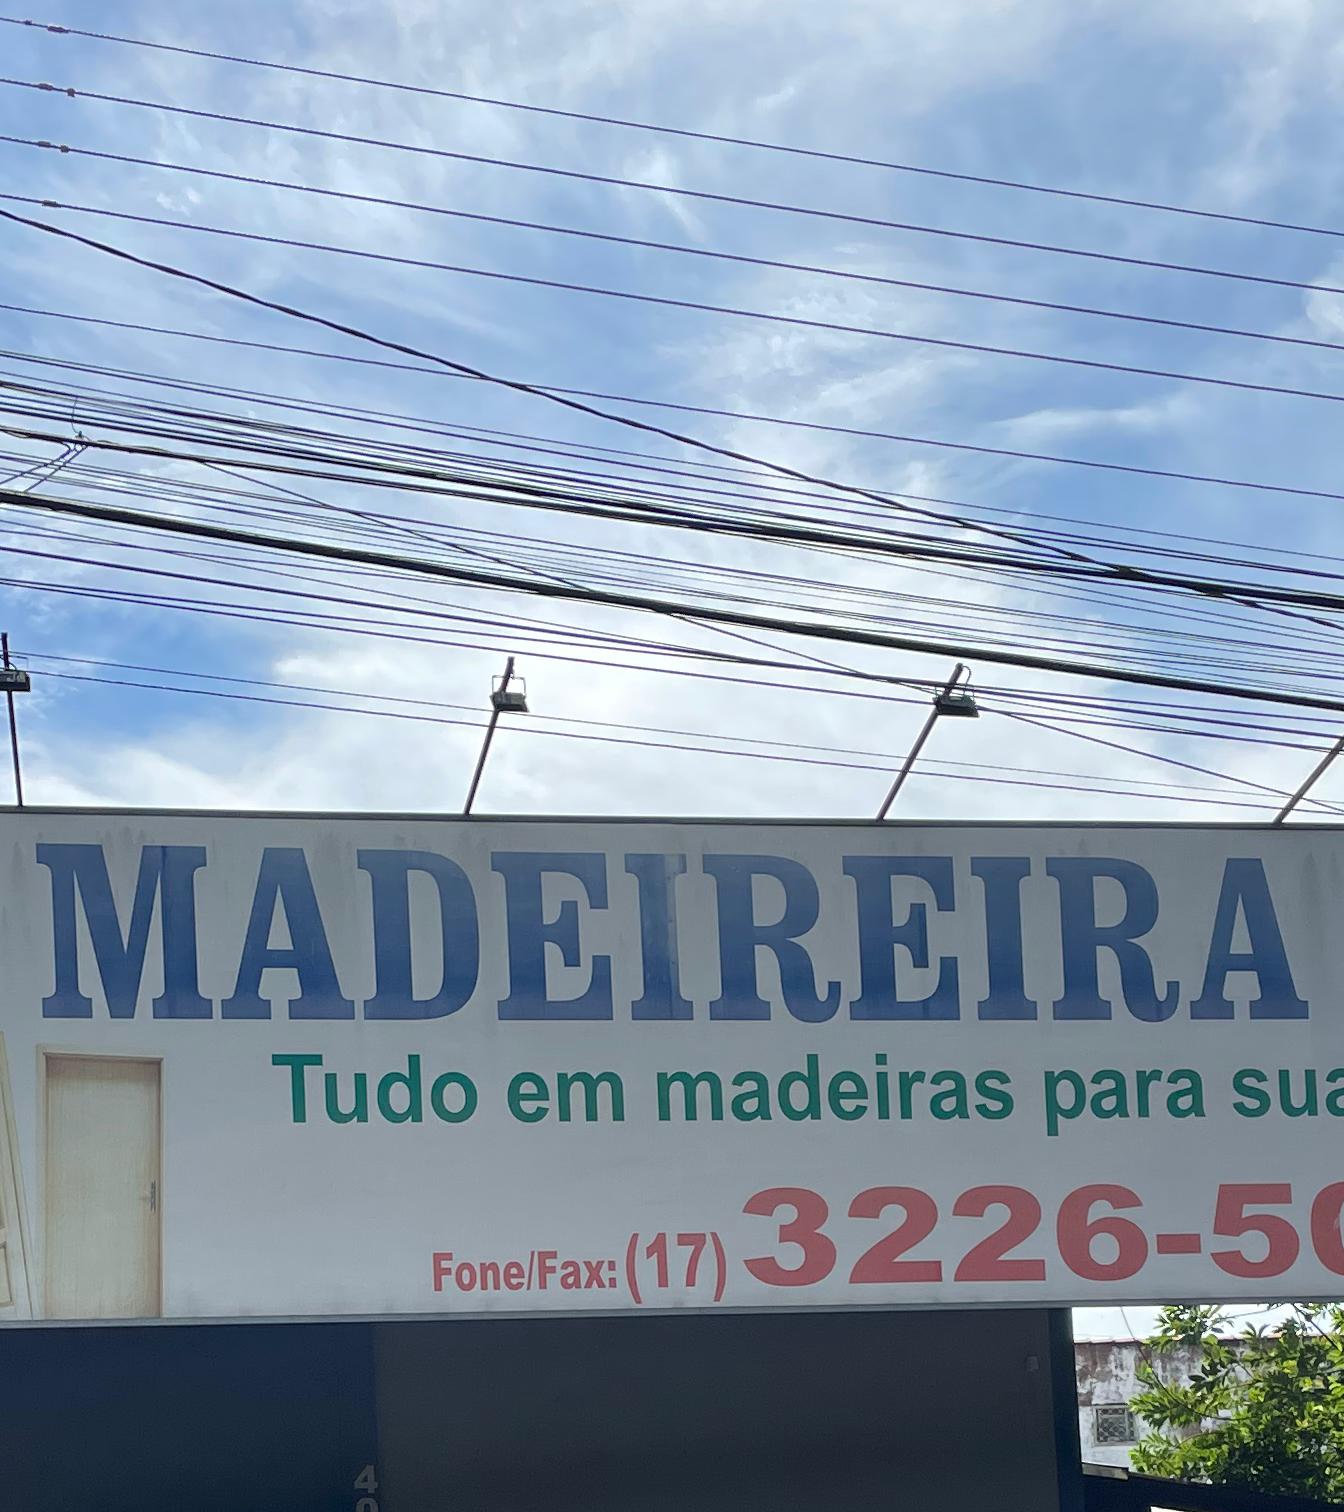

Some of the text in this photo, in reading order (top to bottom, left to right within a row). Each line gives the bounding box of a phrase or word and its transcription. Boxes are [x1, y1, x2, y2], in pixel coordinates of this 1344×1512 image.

[35, 843, 1309, 1022] MADEIREIRA
[270, 1052, 479, 1125] Tudo
[506, 1070, 625, 1123] em
[657, 1053, 1014, 1122] madeiras
[1044, 1067, 1205, 1136] para
[624, 1232, 728, 1302] (17)
